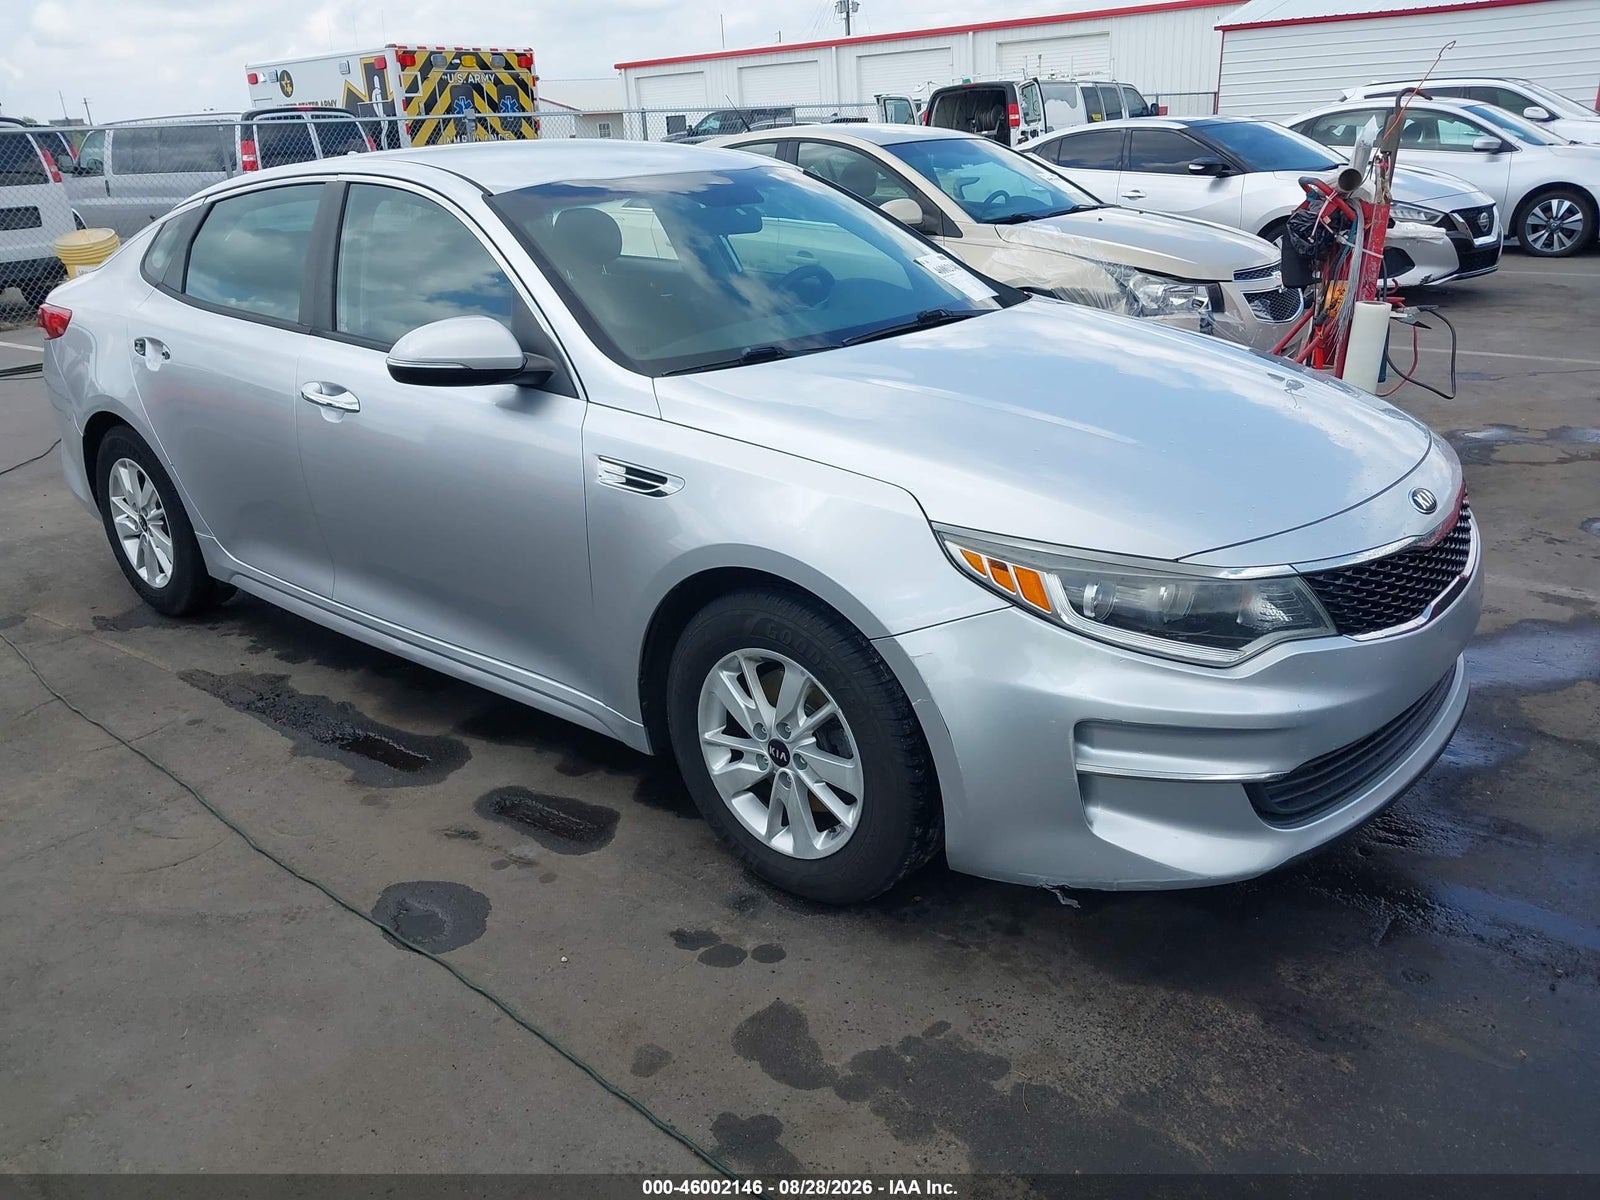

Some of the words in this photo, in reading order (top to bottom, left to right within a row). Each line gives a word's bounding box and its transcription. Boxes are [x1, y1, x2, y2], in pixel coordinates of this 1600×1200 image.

[447, 73, 467, 84] U.S.
[468, 73, 496, 84] ARMY
[769, 745, 787, 762] KIA
